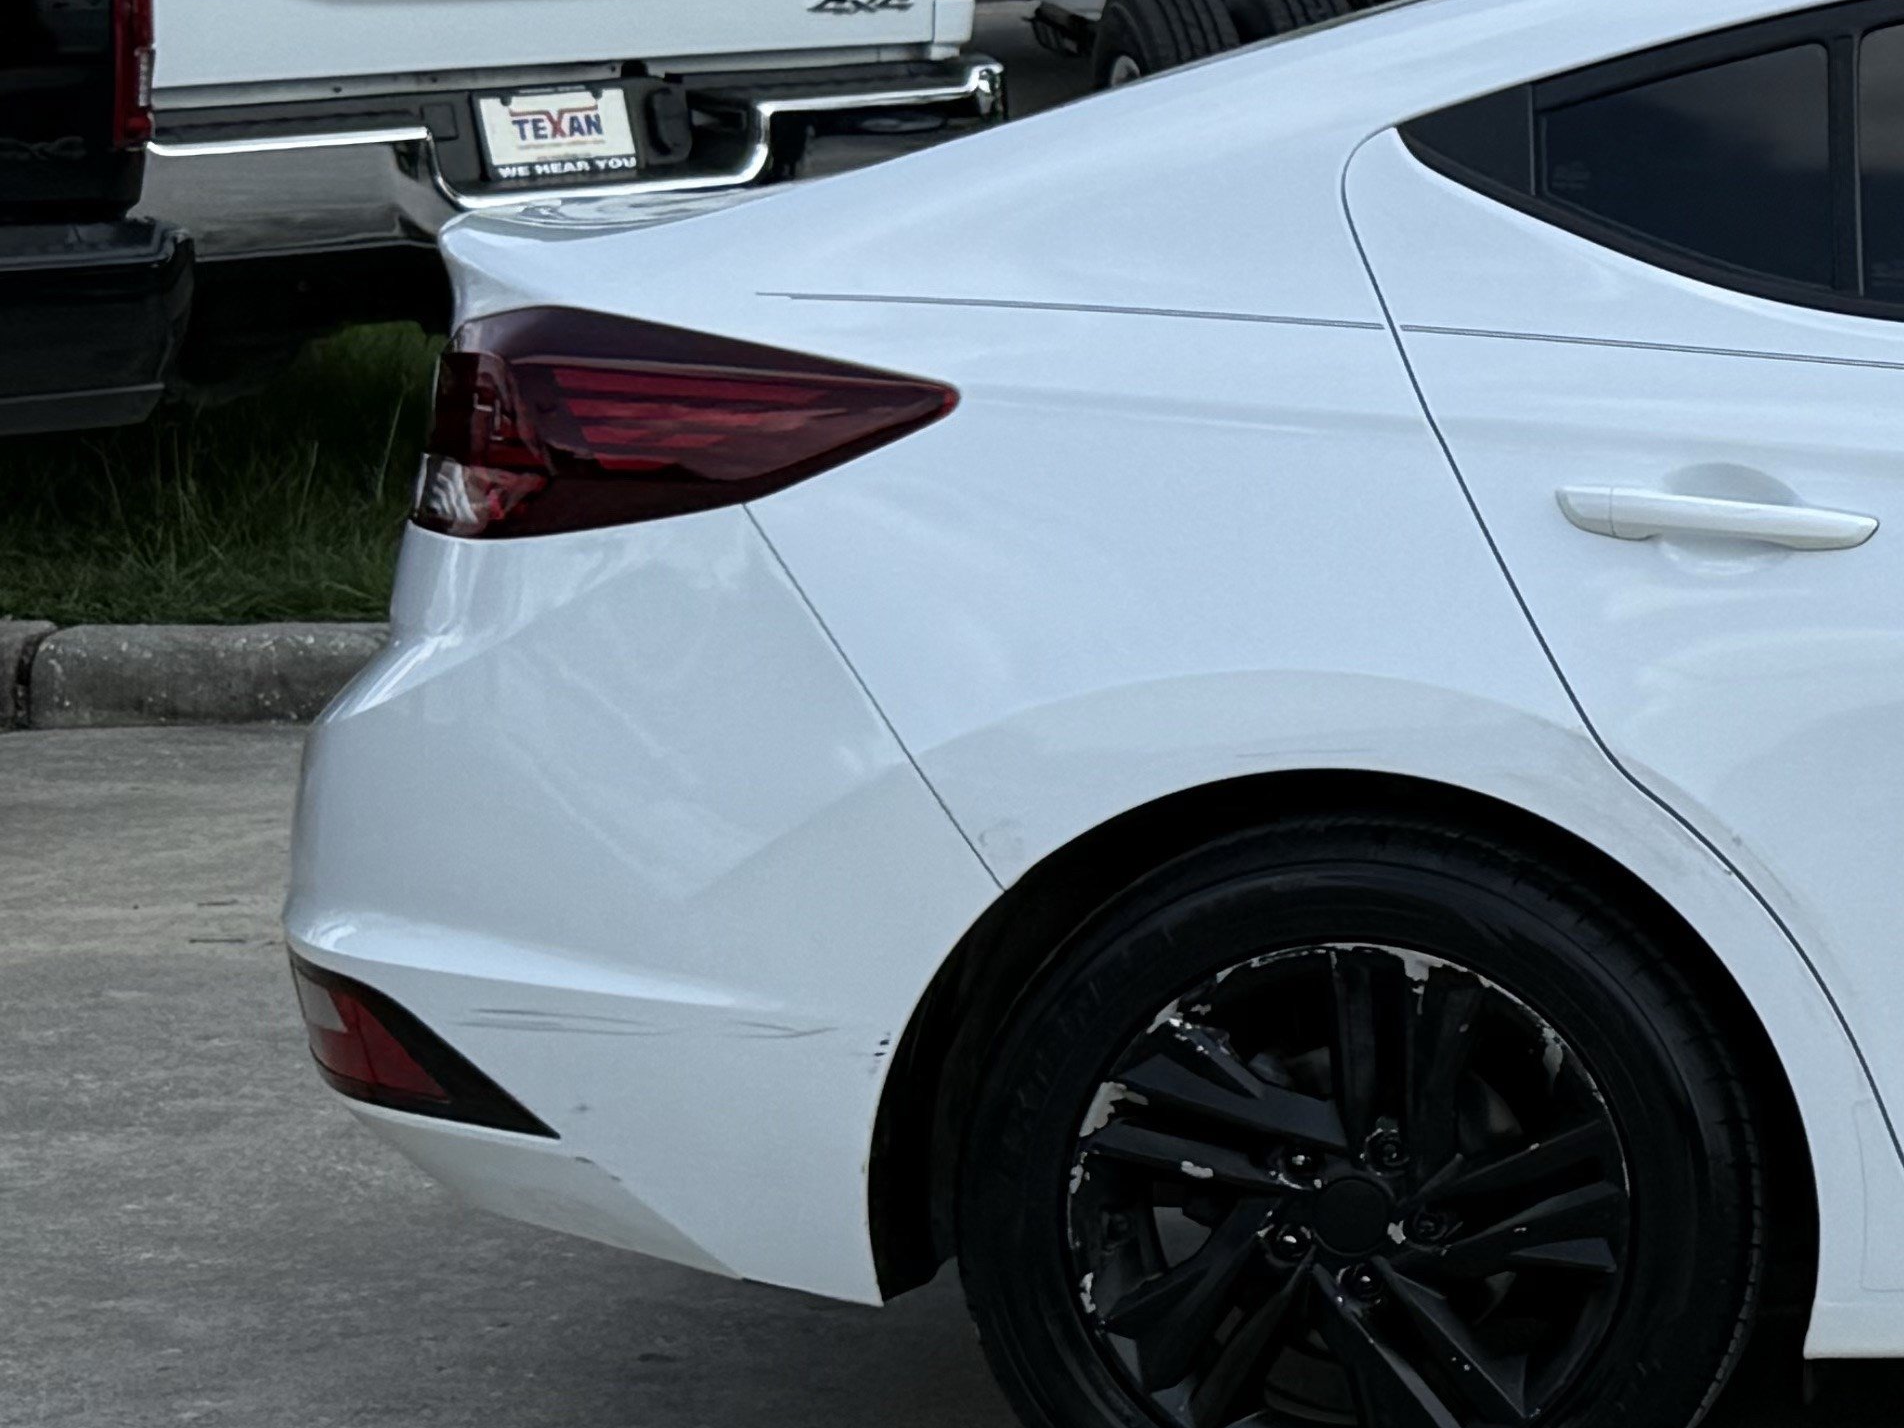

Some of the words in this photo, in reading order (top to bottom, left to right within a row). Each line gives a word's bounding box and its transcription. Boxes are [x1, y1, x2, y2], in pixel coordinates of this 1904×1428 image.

[510, 105, 604, 141] TEXAN
[497, 165, 530, 179] WE
[535, 160, 591, 175] HEAR
[595, 156, 637, 170] YOU
